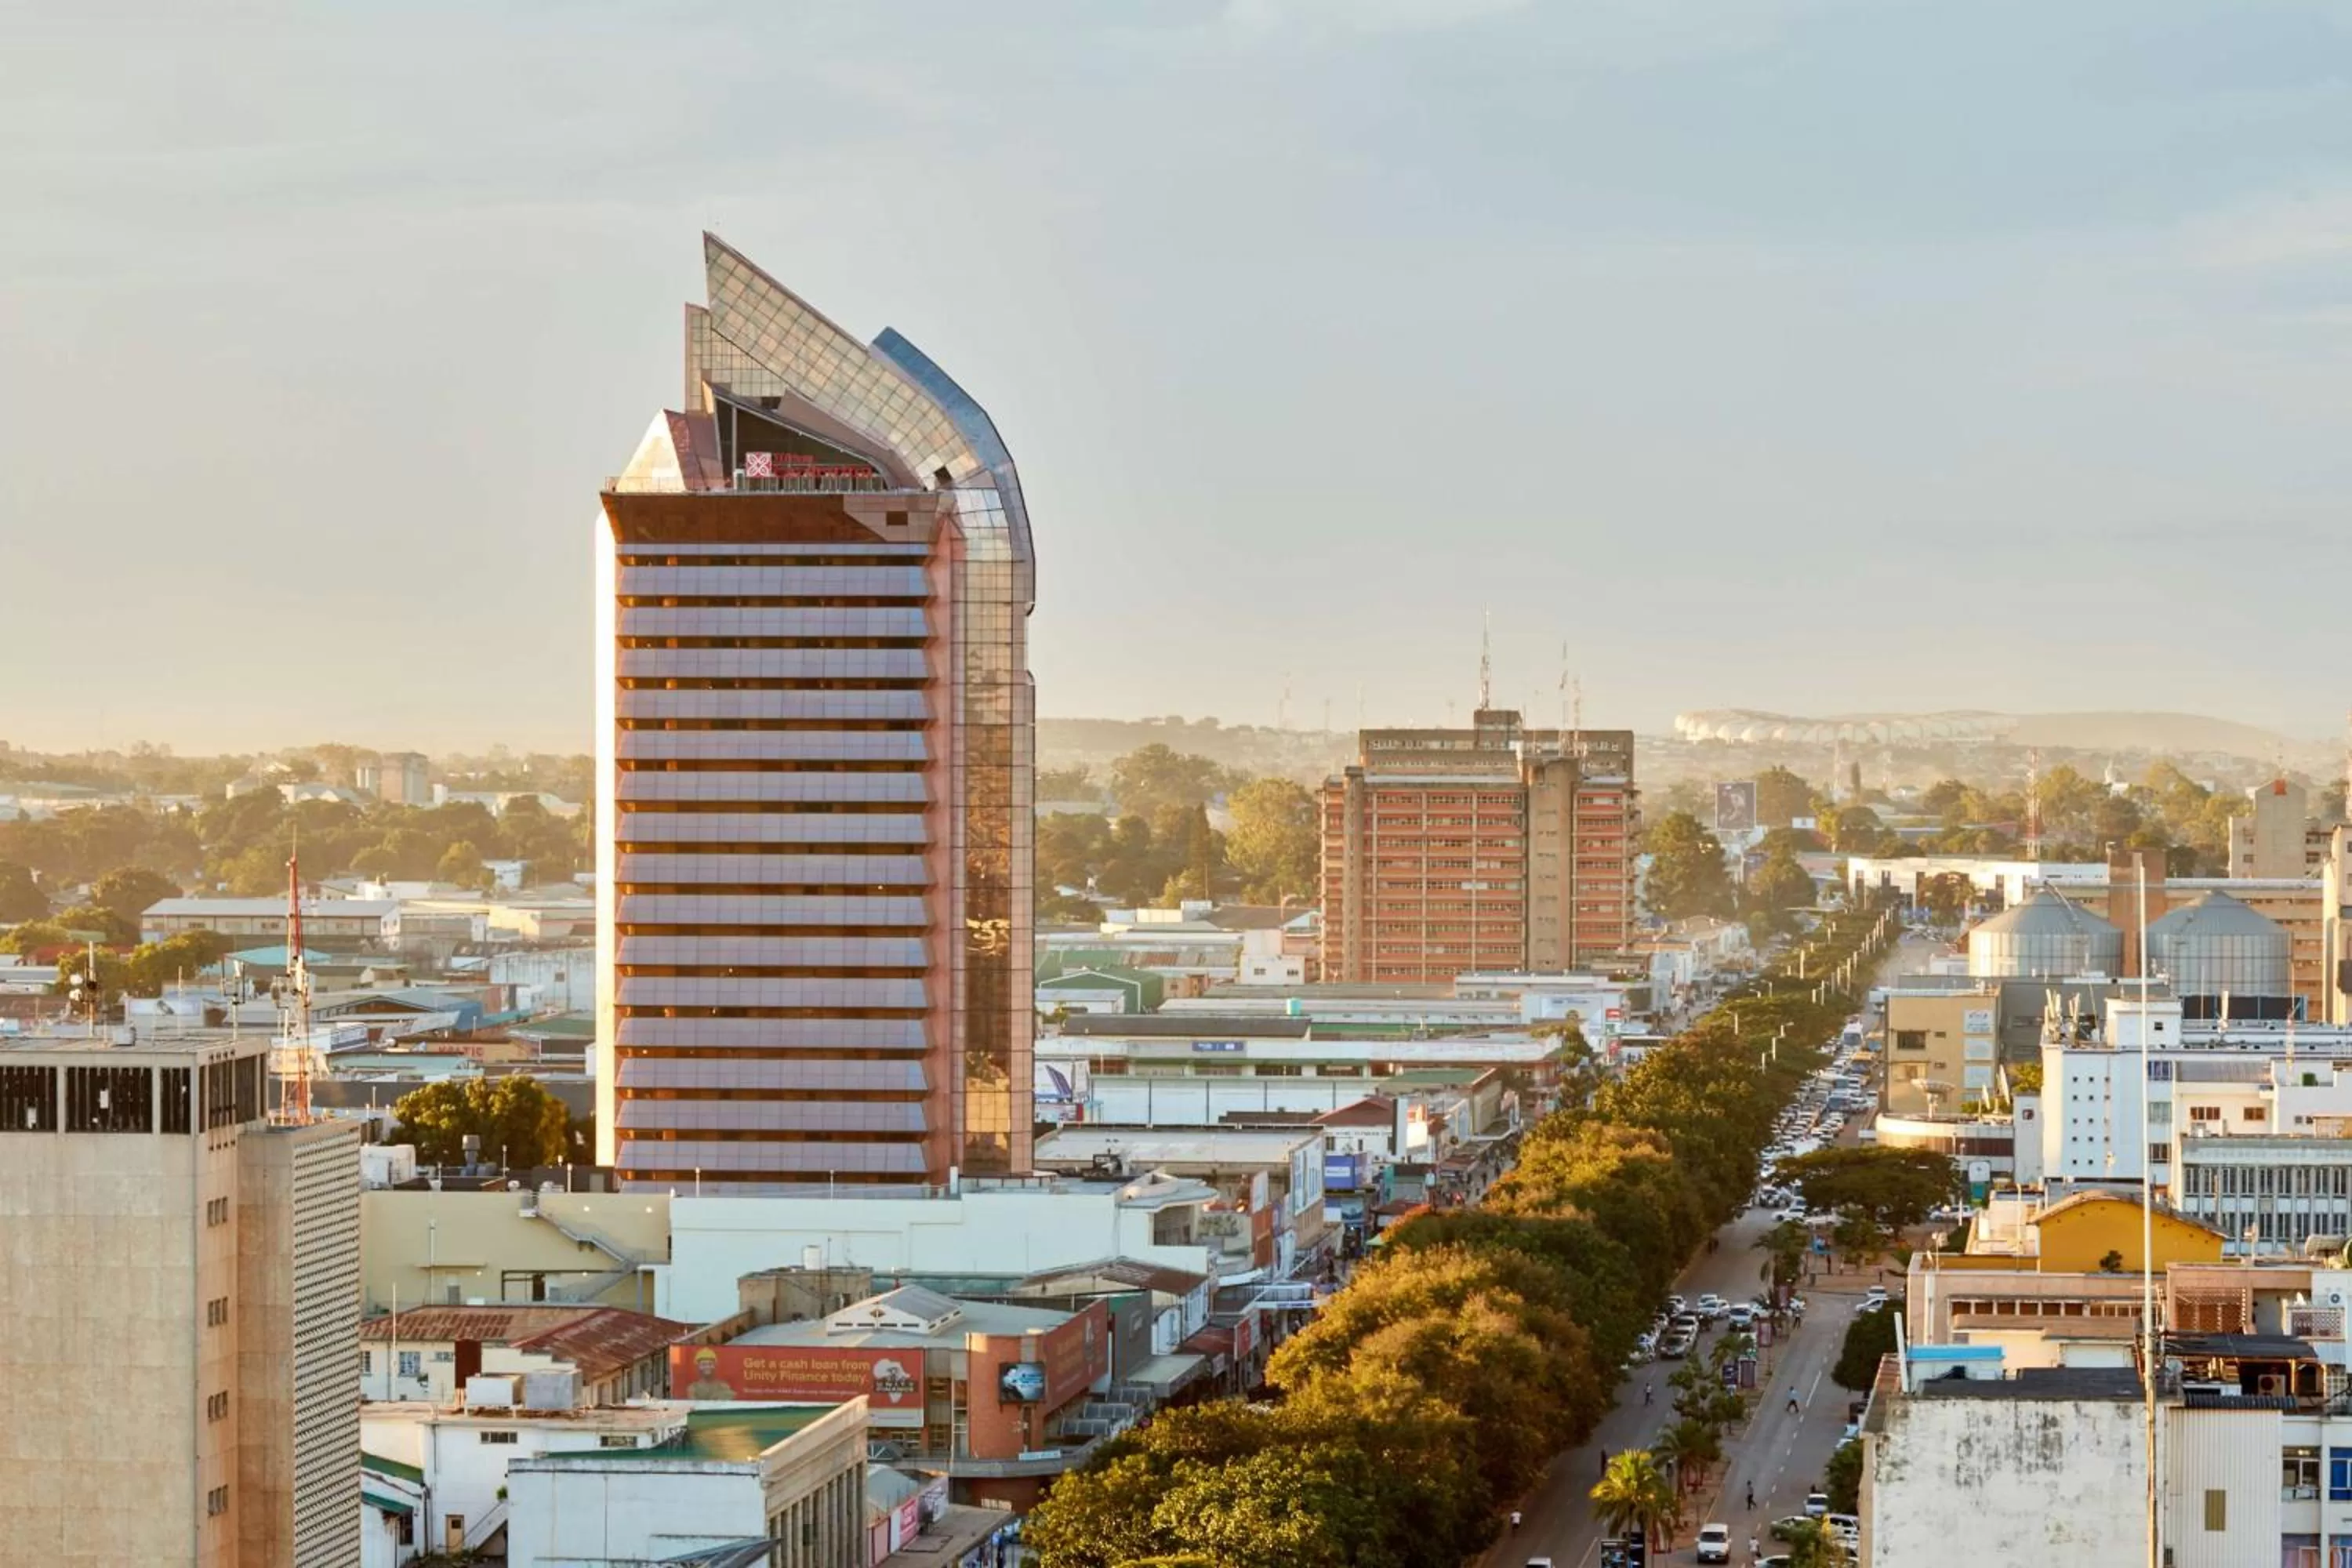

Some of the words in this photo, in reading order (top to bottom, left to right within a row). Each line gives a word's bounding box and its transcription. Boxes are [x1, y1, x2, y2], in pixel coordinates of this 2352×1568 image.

[743, 1357, 765, 1368] Get
[768, 1360, 776, 1369] a
[779, 1357, 808, 1370] cash
[811, 1358, 838, 1370] loan
[841, 1359, 870, 1371] from
[743, 1370, 776, 1383] Unity
[780, 1370, 829, 1382] Finance
